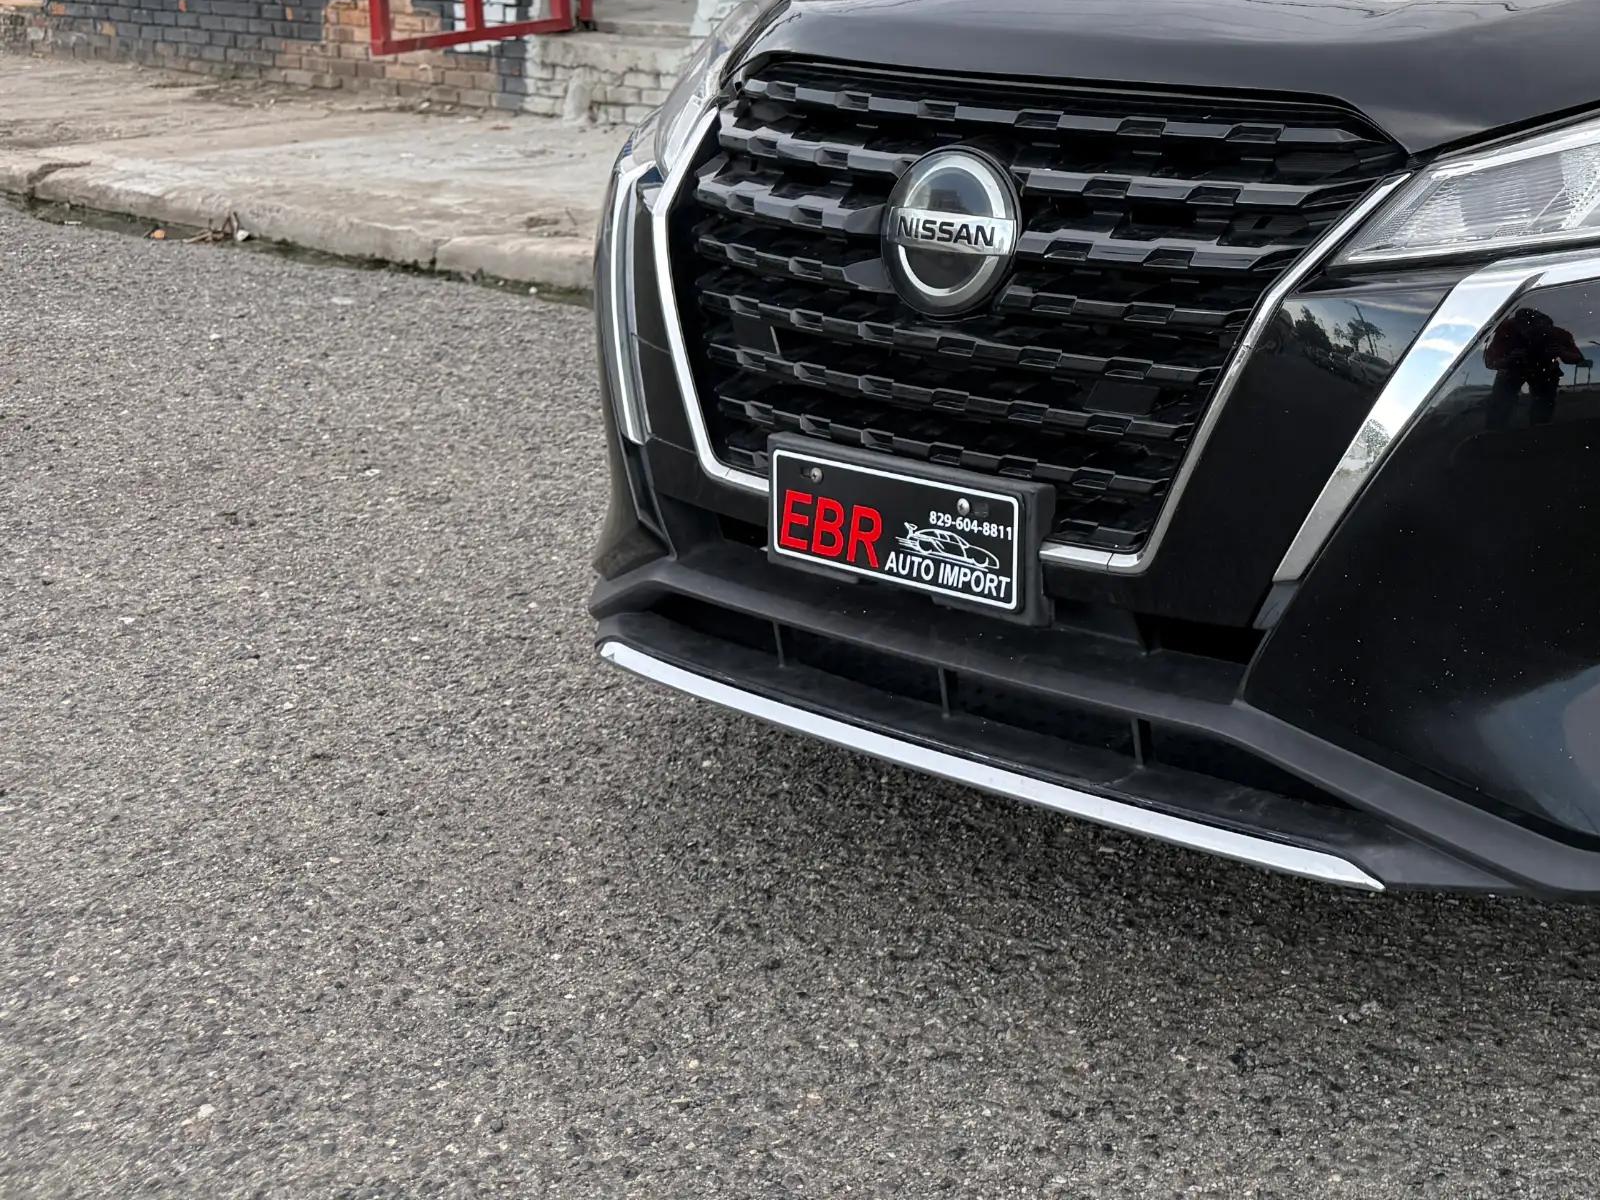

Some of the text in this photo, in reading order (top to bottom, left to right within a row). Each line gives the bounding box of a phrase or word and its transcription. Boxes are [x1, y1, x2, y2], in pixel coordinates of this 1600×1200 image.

[897, 215, 996, 247] NISSAN
[780, 489, 883, 569] EBR
[929, 510, 1014, 541] 829-604-8811
[884, 551, 1011, 599] AUTO IMPORT
